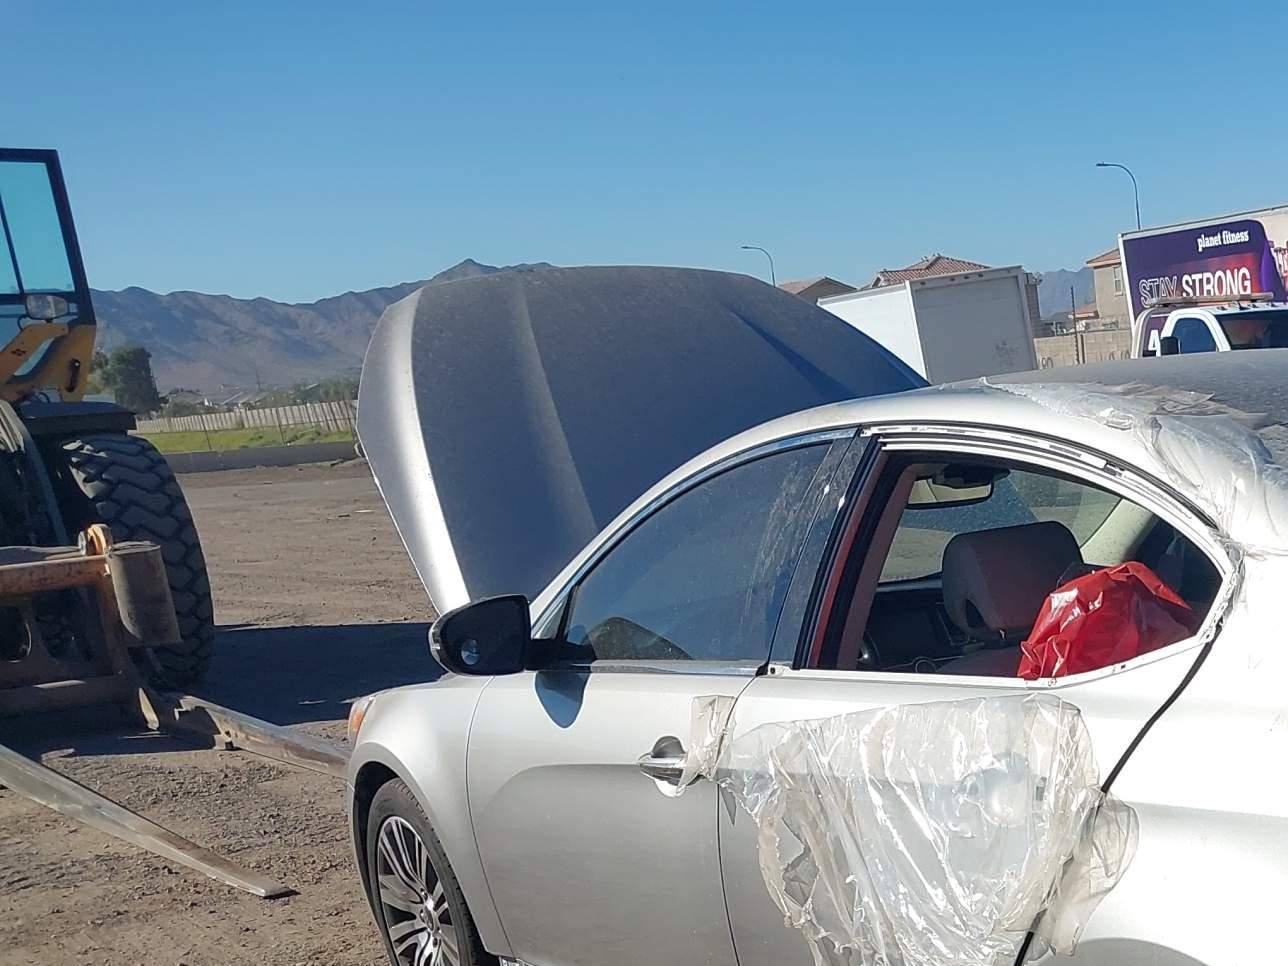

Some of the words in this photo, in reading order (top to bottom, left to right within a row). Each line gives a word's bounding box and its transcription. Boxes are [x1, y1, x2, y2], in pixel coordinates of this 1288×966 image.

[1197, 233, 1222, 252] planet
[1223, 230, 1249, 246] fitness
[1138, 276, 1177, 308] STAY
[1182, 267, 1250, 297] STRONG
